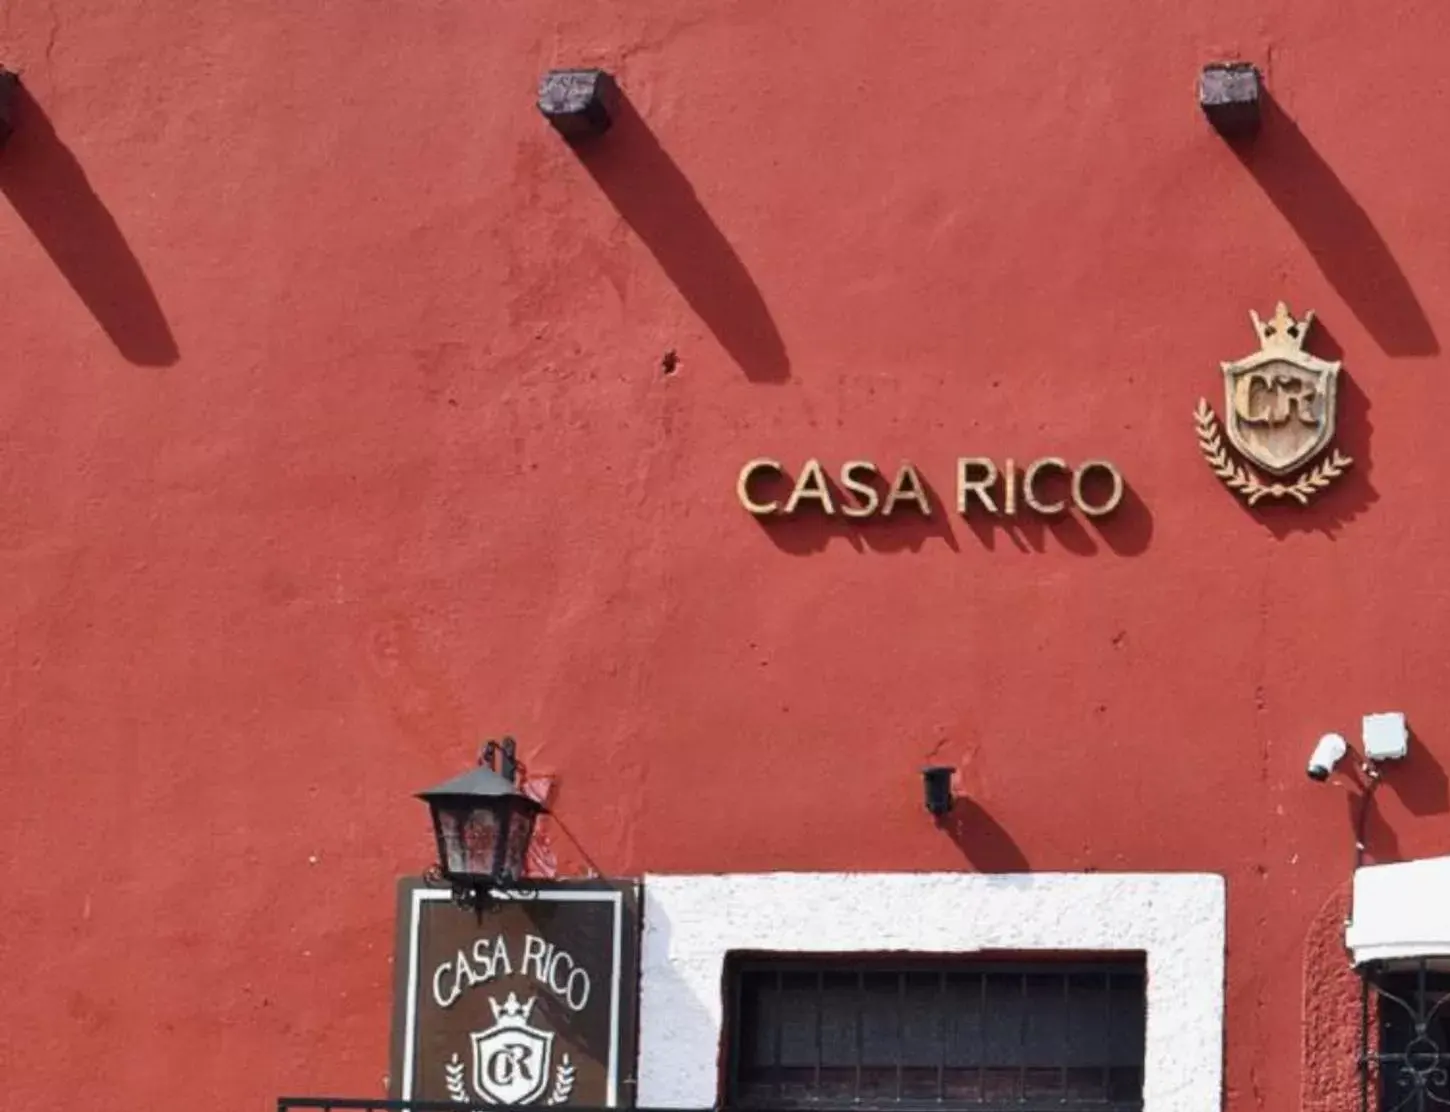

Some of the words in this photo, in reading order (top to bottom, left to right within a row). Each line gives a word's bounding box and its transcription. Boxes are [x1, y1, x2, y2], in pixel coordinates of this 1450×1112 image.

[1234, 374, 1325, 424] CR
[736, 457, 932, 517] CASA
[956, 457, 1124, 516] RICO
[432, 934, 512, 1007] CASA
[520, 934, 591, 1011] RICO
[487, 1043, 533, 1087] CR
